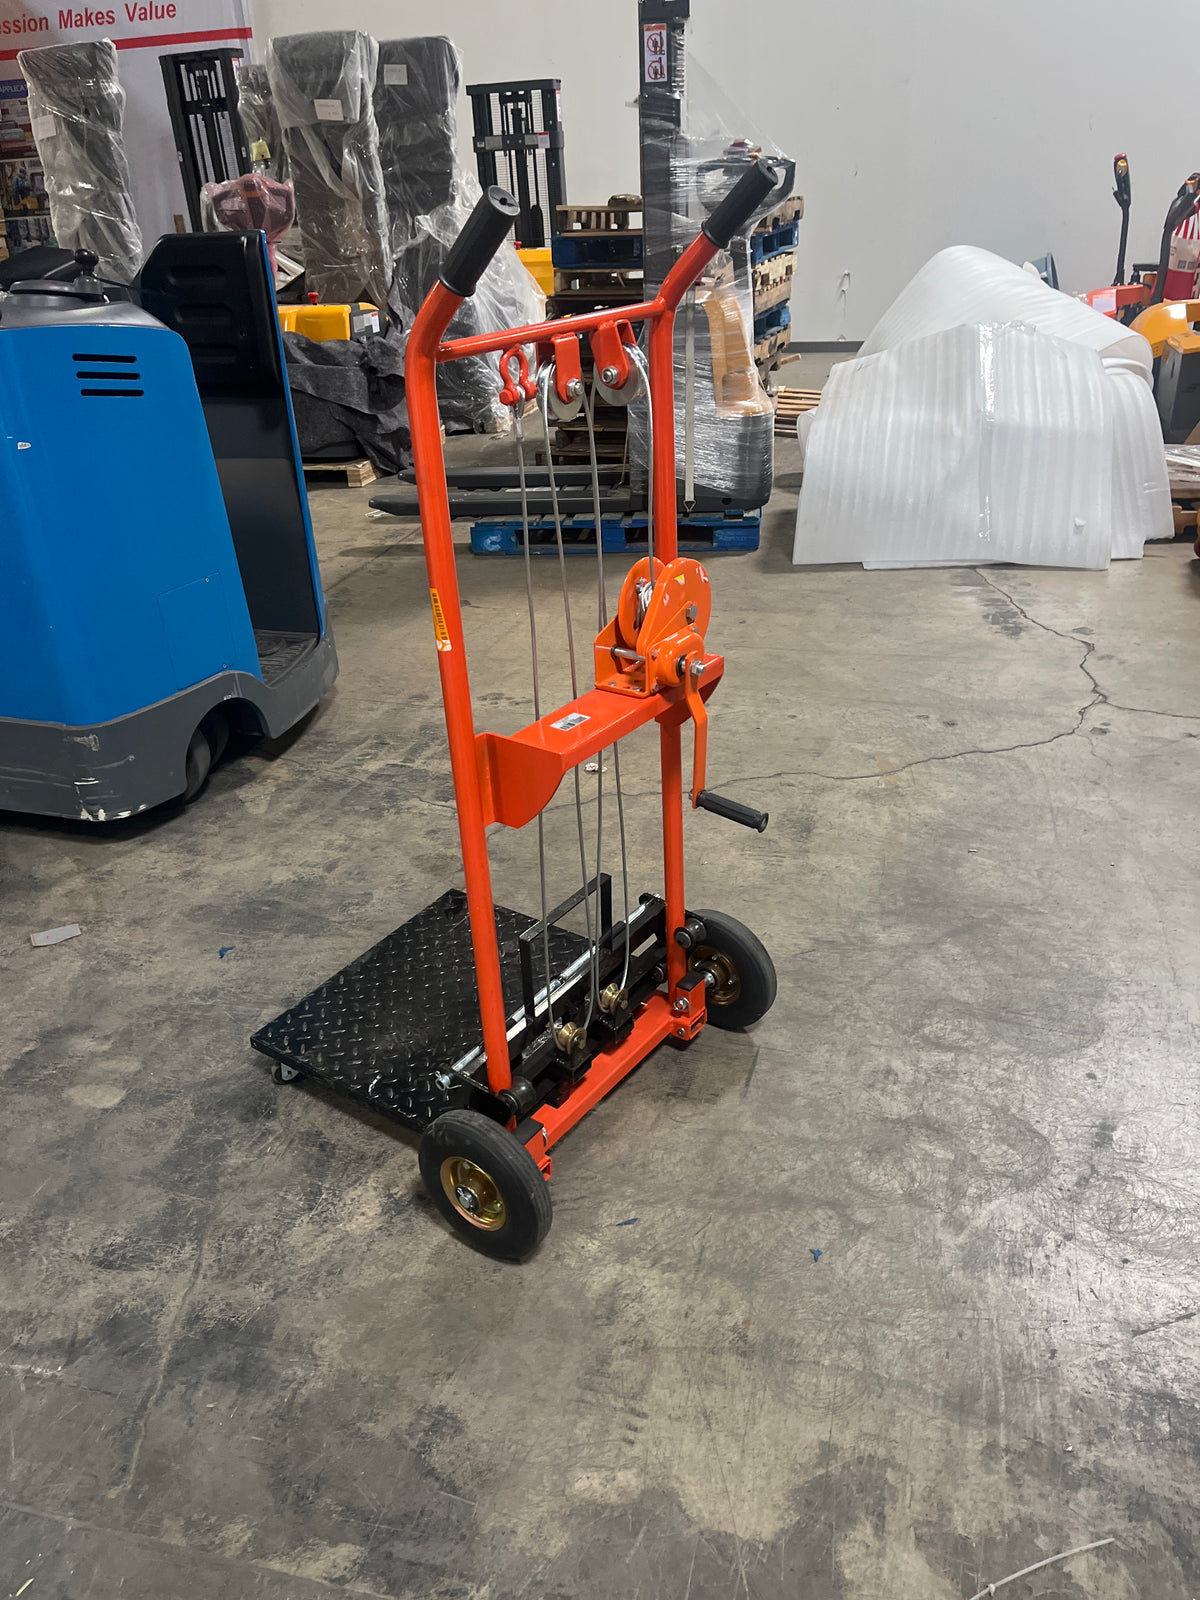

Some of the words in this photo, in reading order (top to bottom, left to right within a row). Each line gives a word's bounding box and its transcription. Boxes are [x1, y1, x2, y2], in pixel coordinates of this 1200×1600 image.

[0, 13, 49, 35] ssion
[58, 7, 116, 30] Makes
[124, 0, 177, 23] Value
